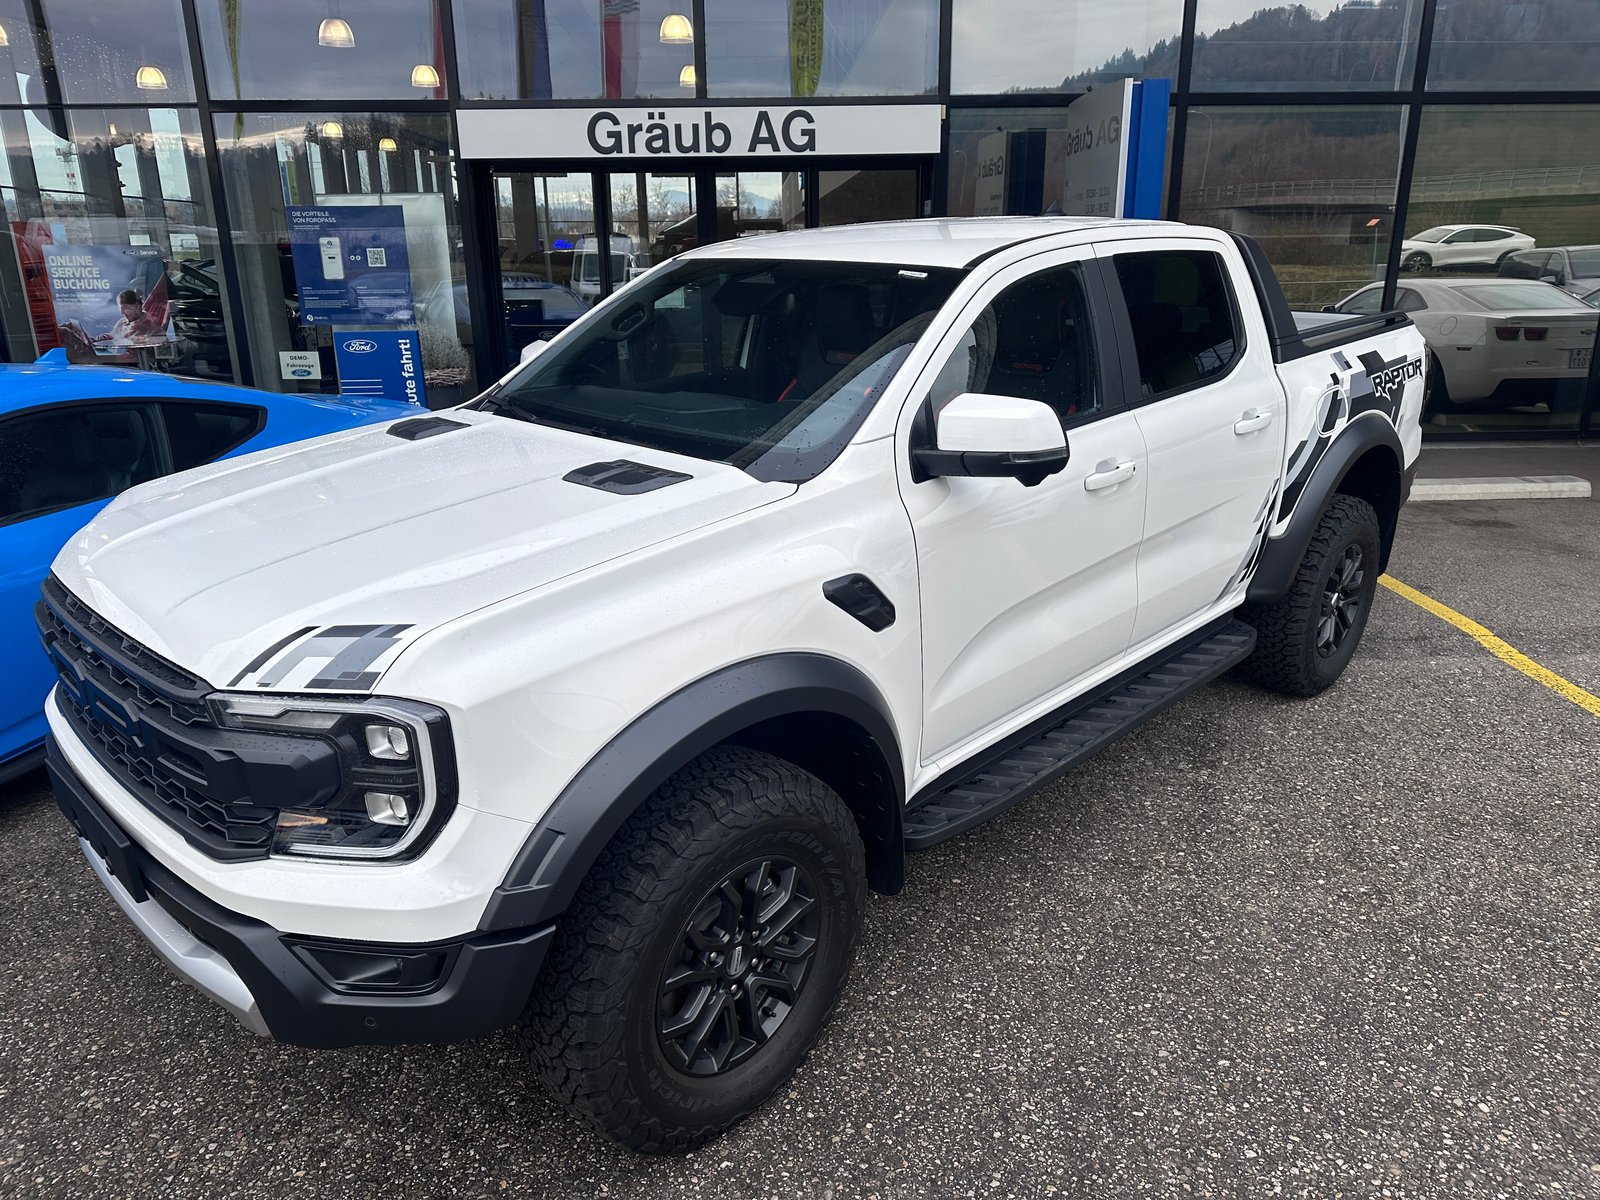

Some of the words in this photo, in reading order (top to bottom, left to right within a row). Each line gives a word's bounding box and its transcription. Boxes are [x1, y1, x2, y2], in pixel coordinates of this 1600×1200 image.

[587, 111, 731, 155] Gräub
[747, 109, 817, 153] AG
[48, 255, 93, 266] ONLINE
[51, 267, 100, 278] SERVICE
[53, 279, 110, 290] BUCHUNG
[398, 339, 415, 378] fahrt!
[1371, 357, 1424, 401] RAPTOR
